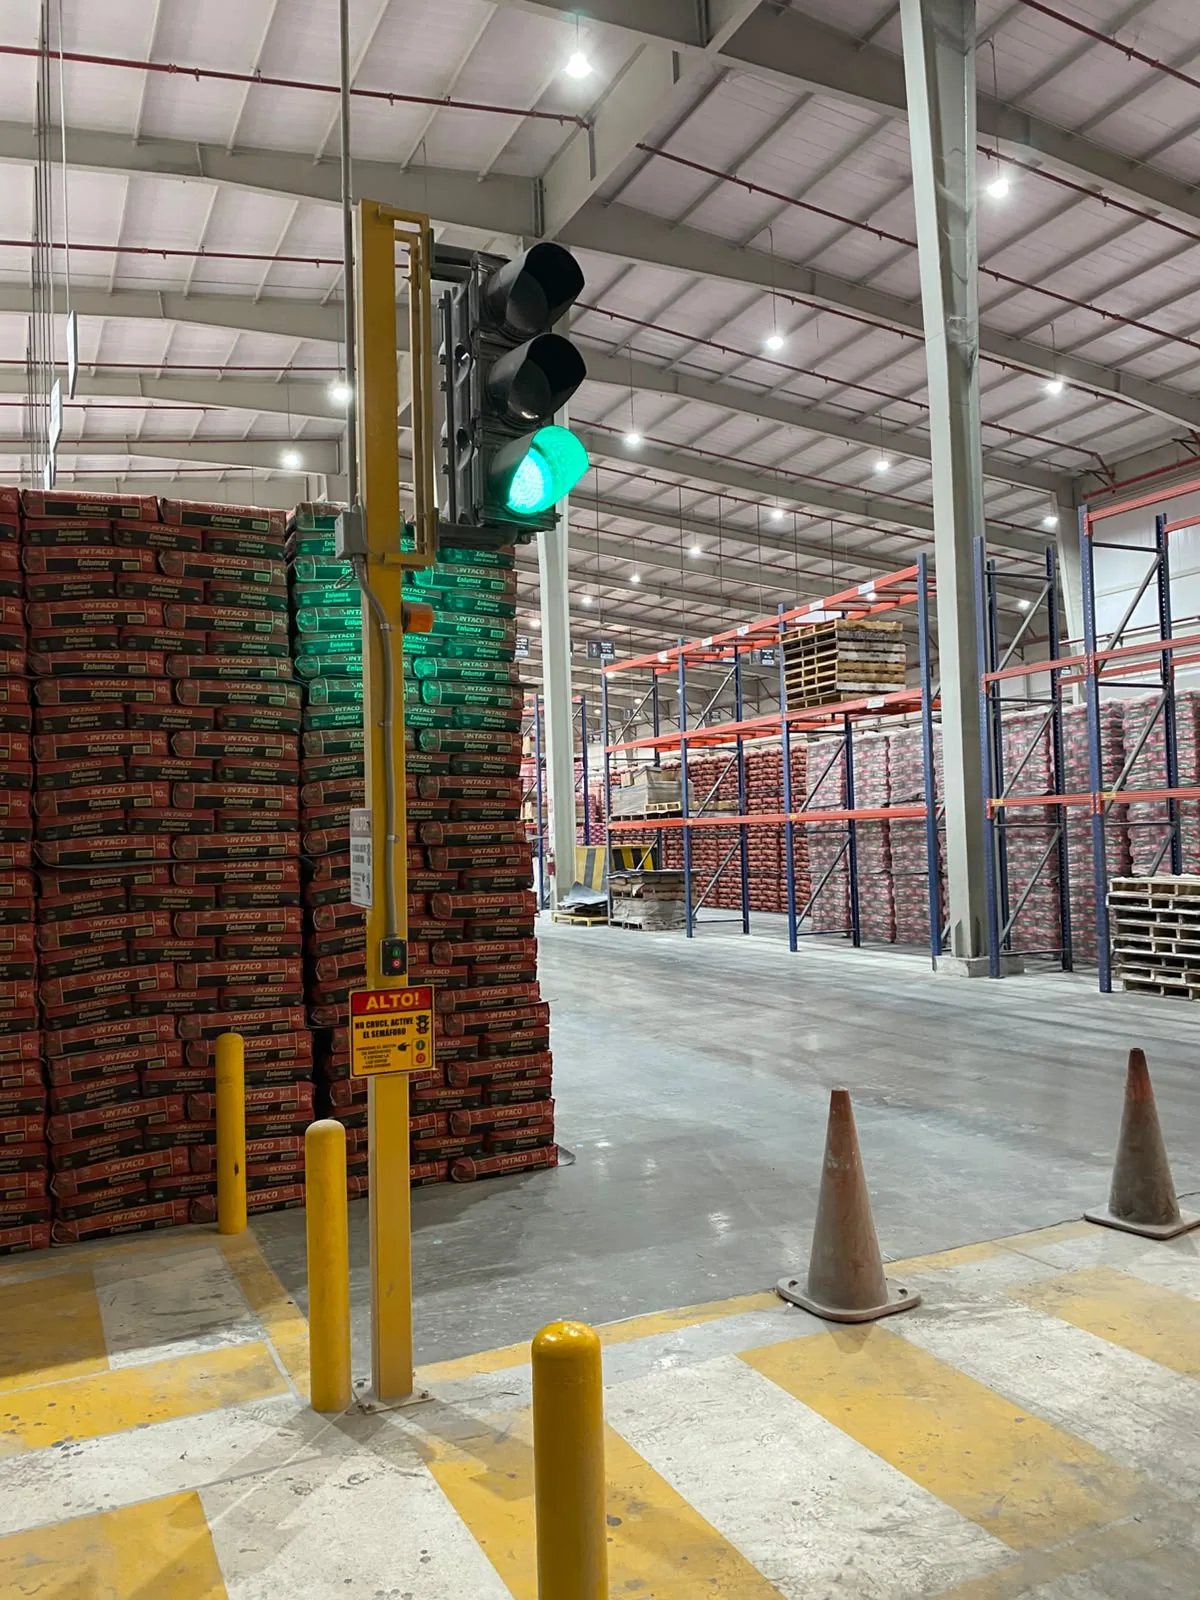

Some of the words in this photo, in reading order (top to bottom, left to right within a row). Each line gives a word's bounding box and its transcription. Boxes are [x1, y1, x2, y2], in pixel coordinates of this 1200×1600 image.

[214, 558, 247, 566] INTACO
[92, 917, 127, 926] INTACO
[95, 971, 130, 982] INTACO
[366, 992, 420, 1010] ALTO!
[96, 1023, 130, 1033] INTACO
[355, 1021, 365, 1029] NO
[391, 1017, 413, 1026] ACTIVE
[363, 1031, 370, 1039] EL
[244, 1039, 272, 1047] NTACO
[105, 1050, 139, 1060] INTACO
[105, 1105, 140, 1117] INTACO
[246, 1142, 274, 1150] NTACO
[110, 1159, 145, 1172] INTACO
